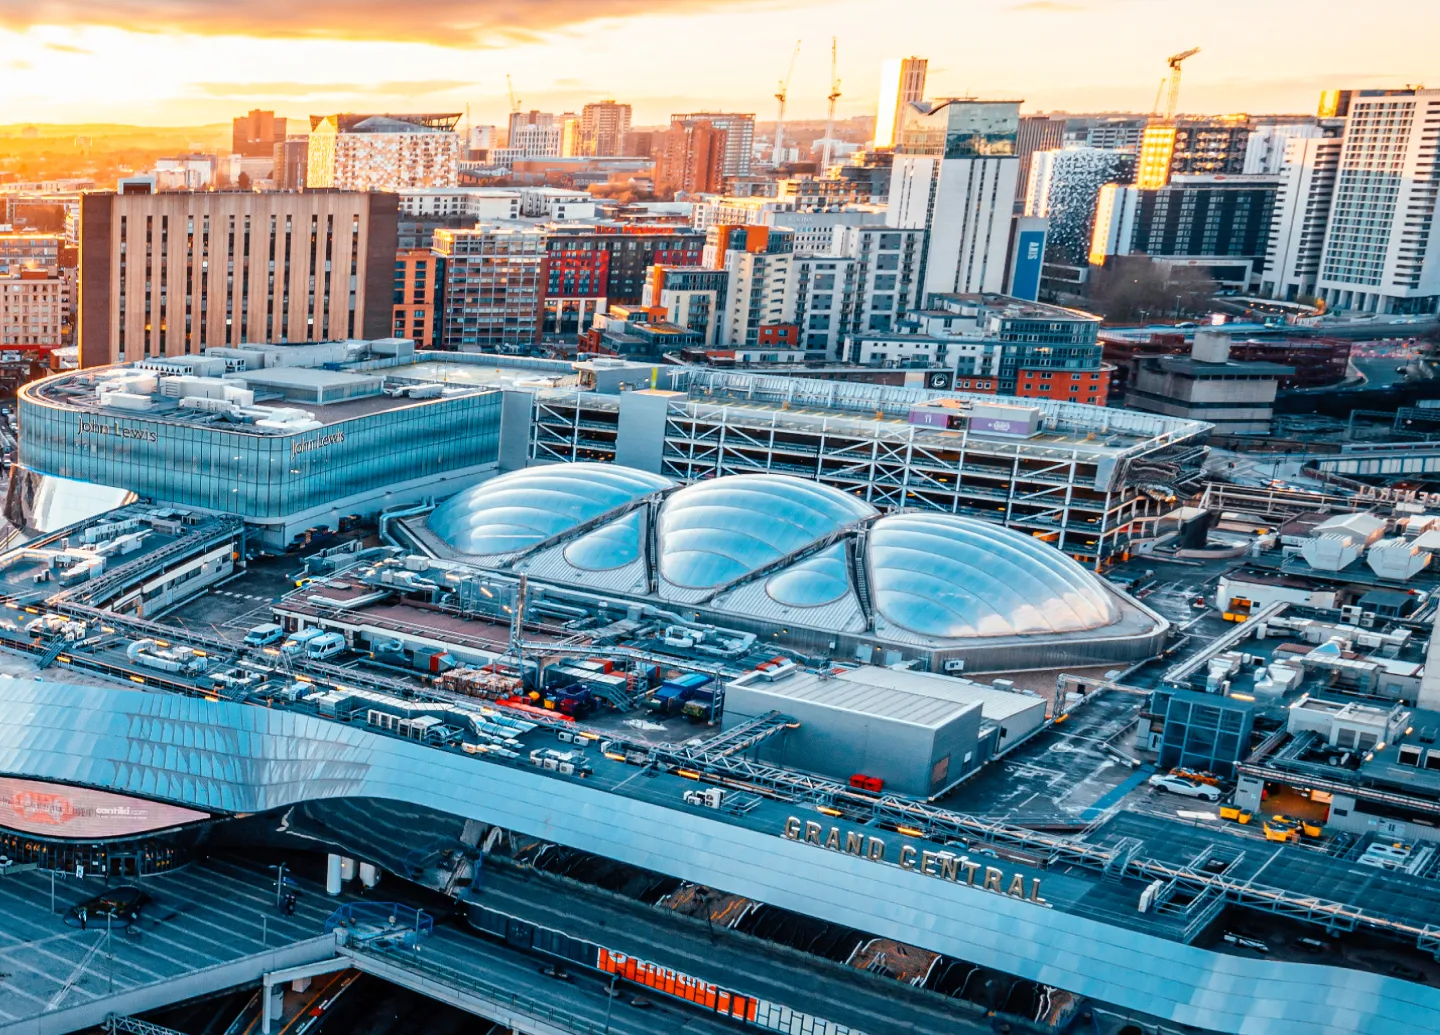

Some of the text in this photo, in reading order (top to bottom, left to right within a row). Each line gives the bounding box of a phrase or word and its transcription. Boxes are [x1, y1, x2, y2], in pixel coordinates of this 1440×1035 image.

[78, 416, 157, 443] John Lewis
[290, 428, 345, 460] John Lewis
[784, 816, 1047, 904] GRAND CENTRAL
